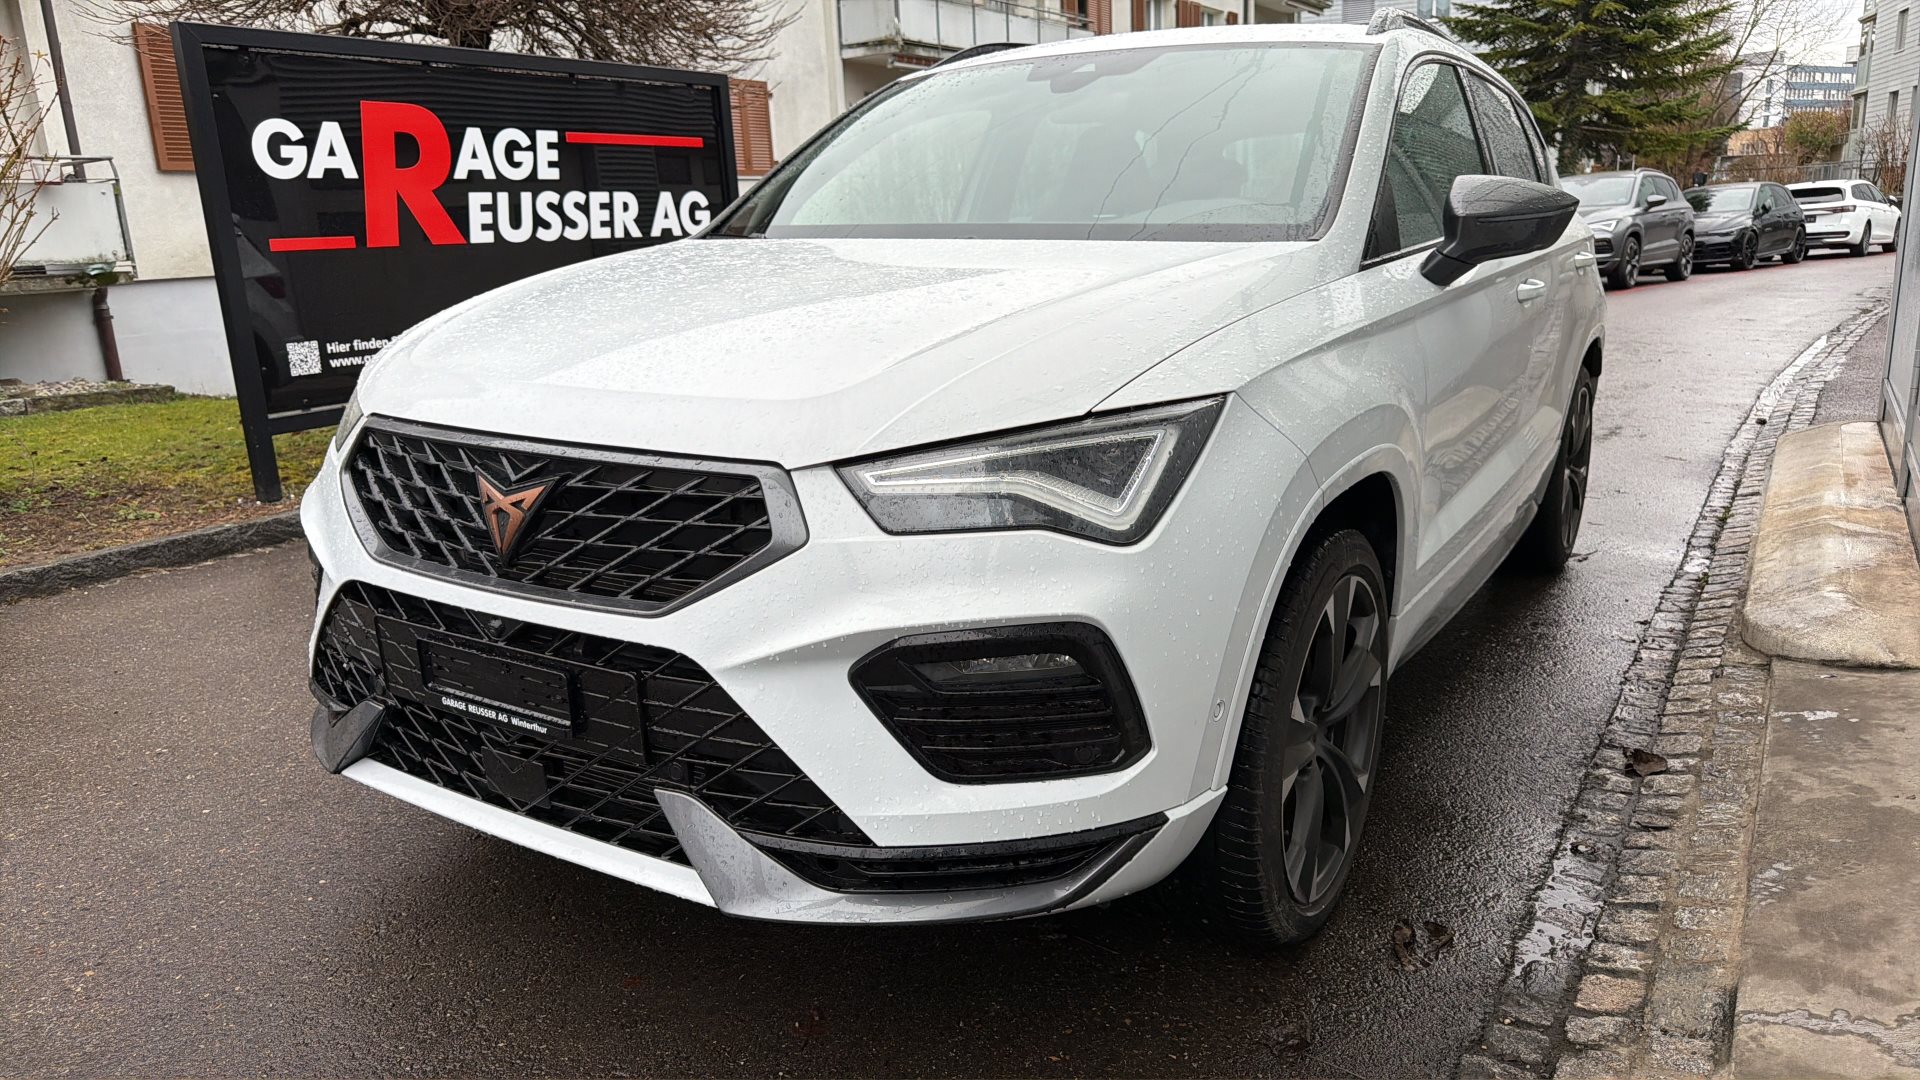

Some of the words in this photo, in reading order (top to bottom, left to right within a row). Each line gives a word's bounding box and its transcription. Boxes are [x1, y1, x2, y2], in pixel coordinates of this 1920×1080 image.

[650, 190, 711, 237] AG
[326, 341, 351, 354] Hier
[441, 696, 467, 711] GARAGE
[468, 704, 497, 720] REUSSER
[498, 712, 509, 723] AG
[511, 716, 548, 734] Winterthur
